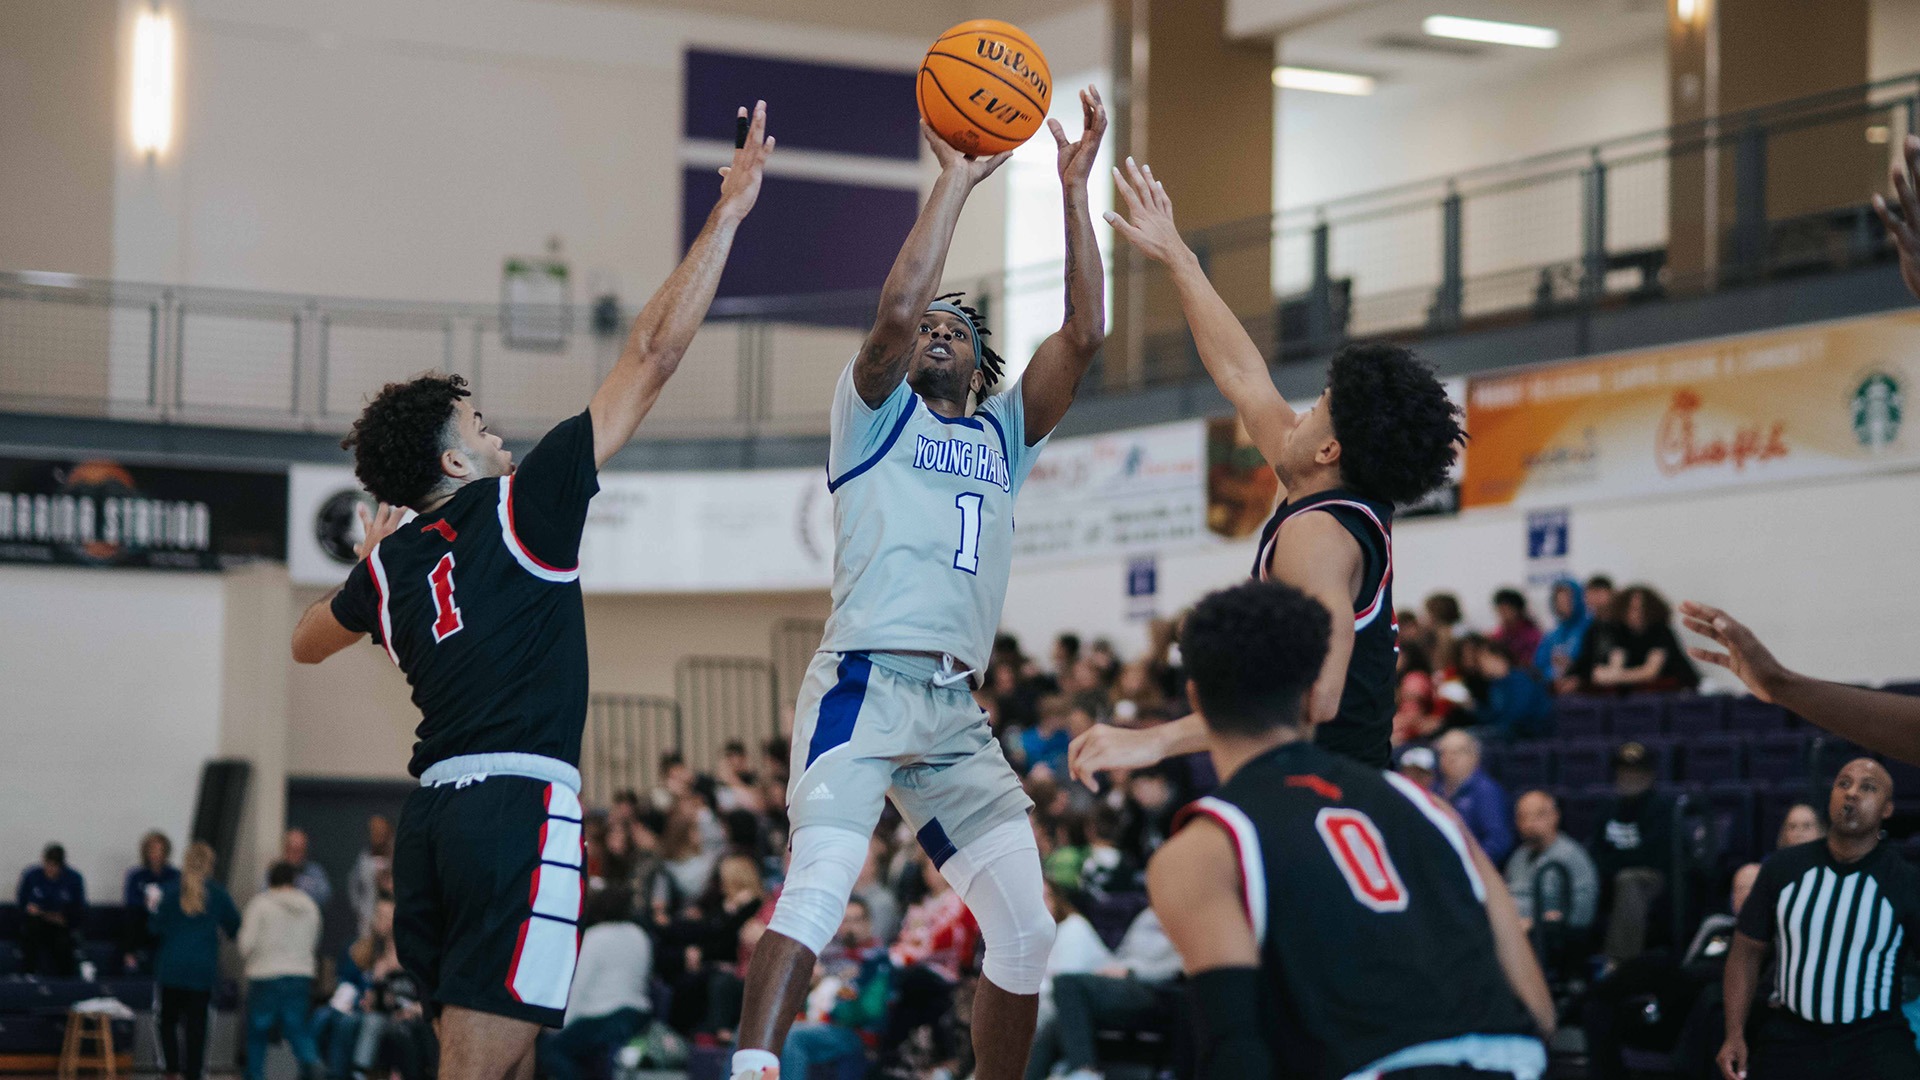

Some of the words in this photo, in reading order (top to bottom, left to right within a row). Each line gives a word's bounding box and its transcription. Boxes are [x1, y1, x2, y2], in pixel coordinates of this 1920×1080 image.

[977, 37, 1048, 101] Wilson
[913, 434, 972, 477] YOUNG
[0, 491, 96, 543] ARRIOR
[953, 491, 984, 576] 1
[427, 551, 464, 644] 1
[806, 793, 835, 801] adidas
[1315, 807, 1409, 913] 0
